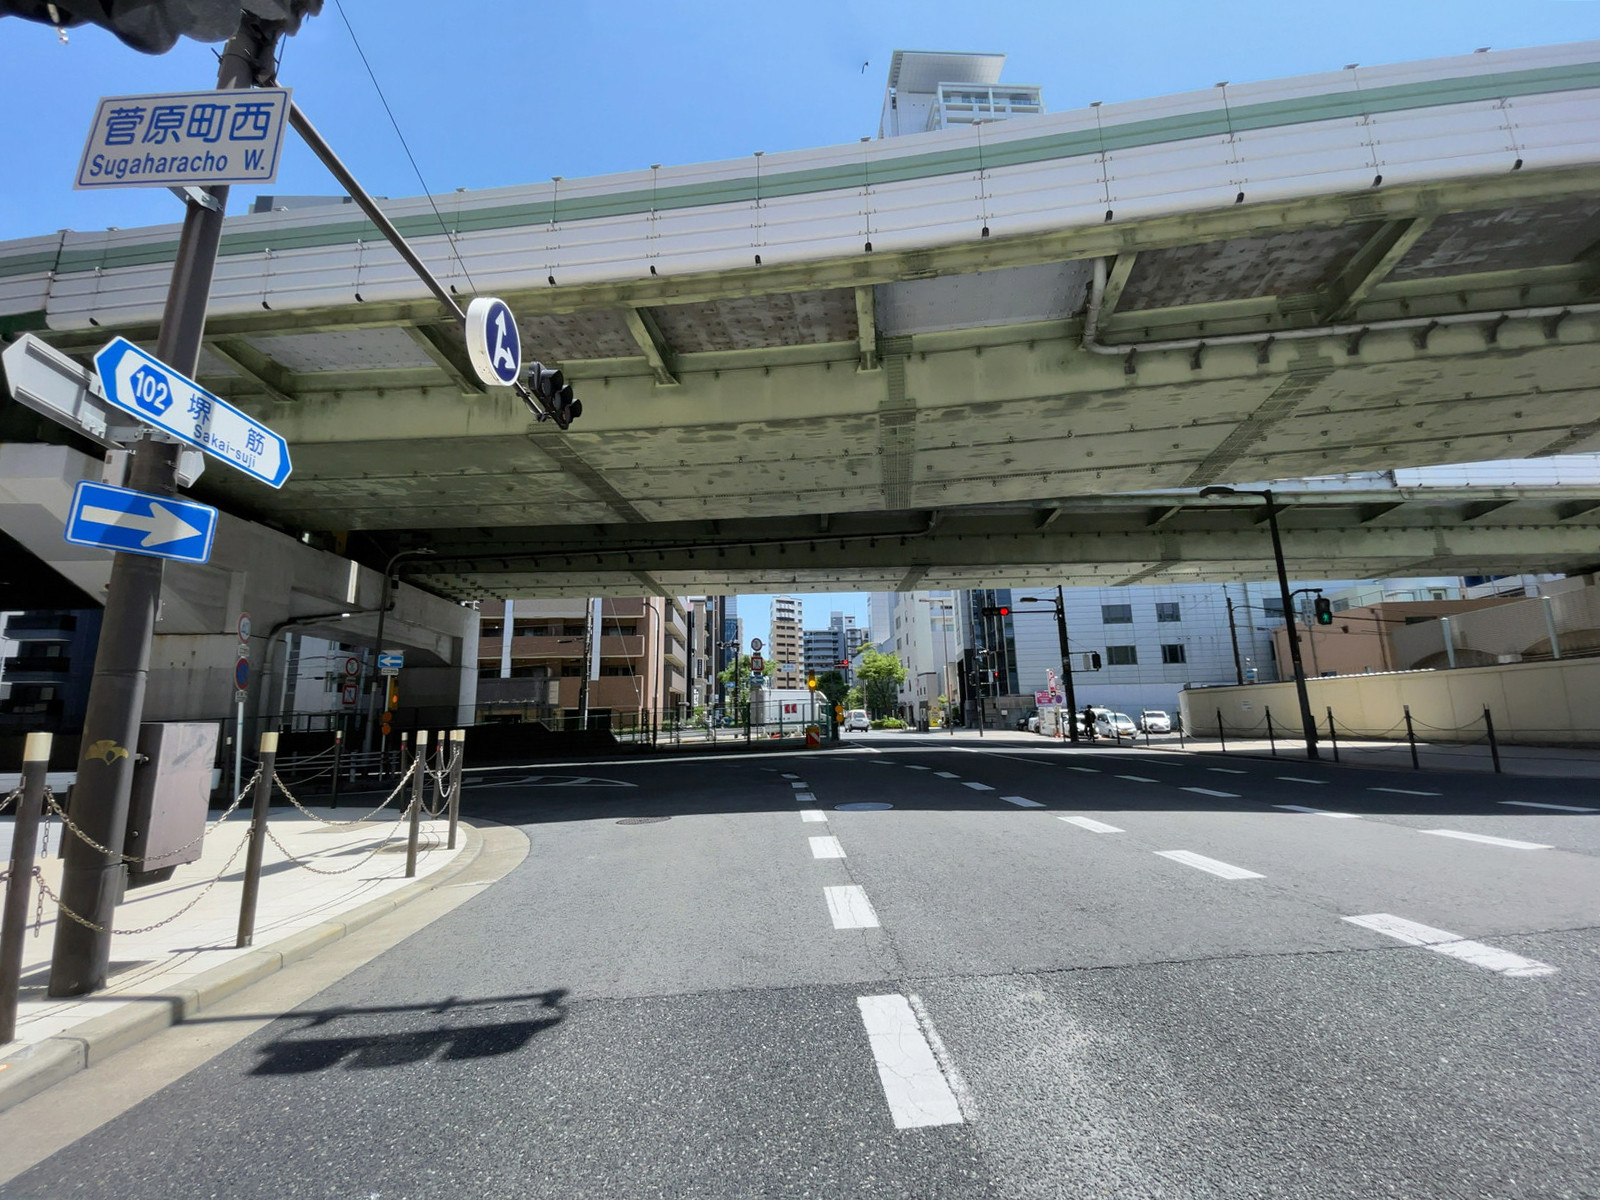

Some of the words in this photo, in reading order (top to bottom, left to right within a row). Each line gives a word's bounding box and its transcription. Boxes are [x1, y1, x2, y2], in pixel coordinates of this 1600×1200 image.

[104, 101, 275, 146] 菅原町西
[89, 149, 228, 179] Sugaharacho
[243, 148, 266, 172] W.
[133, 369, 168, 412] 102
[193, 424, 257, 469] Sakai-suji
